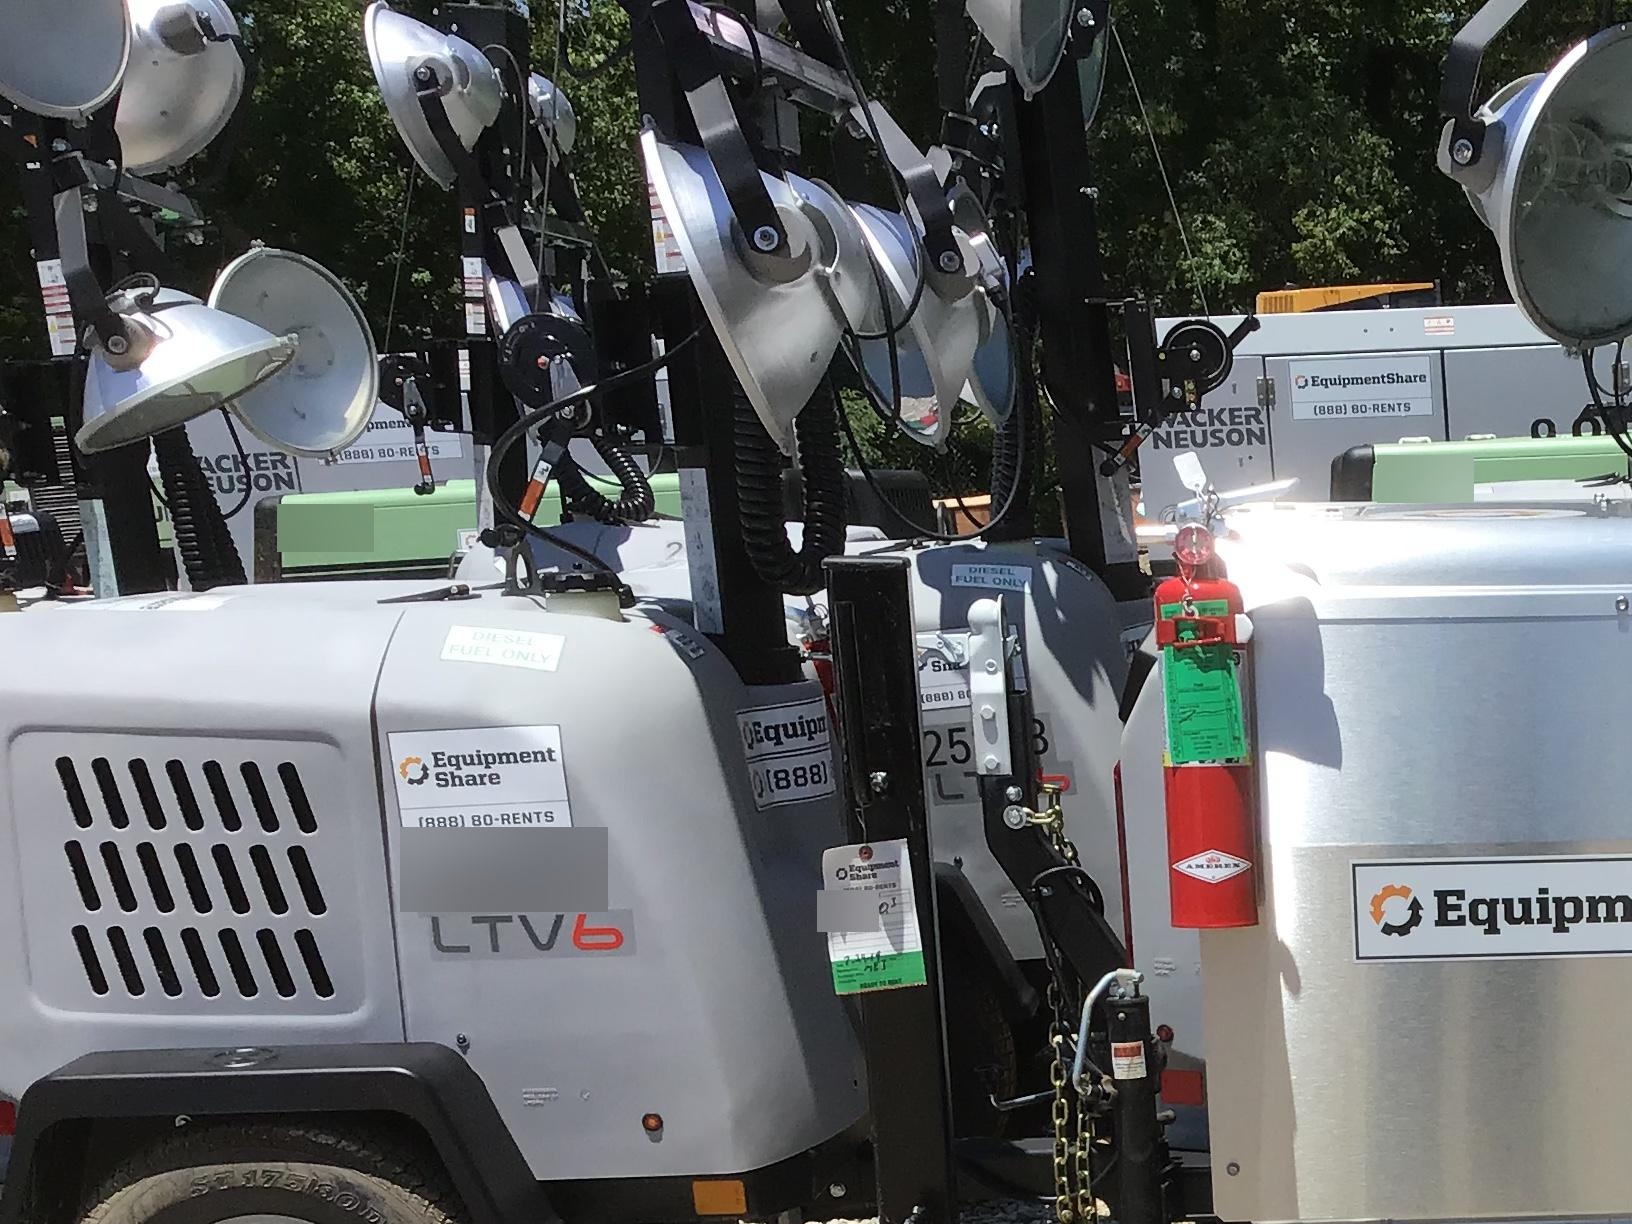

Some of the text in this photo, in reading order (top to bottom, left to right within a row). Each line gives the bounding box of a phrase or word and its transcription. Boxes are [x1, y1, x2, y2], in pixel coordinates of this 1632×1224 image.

[1311, 373, 1427, 388] EquipmentShare
[1313, 403, 1411, 416] (888) 80-RENTS
[1153, 427, 1267, 450] NEUSON
[200, 451, 291, 475] ACKER
[968, 566, 1016, 576] DIESEL
[955, 575, 1027, 588] FUEL ONLY
[432, 747, 557, 770] Equipment
[435, 770, 501, 788] Share
[766, 760, 828, 794] (888)
[471, 810, 555, 827] 80-RENTS
[431, 913, 624, 953] LTV6
